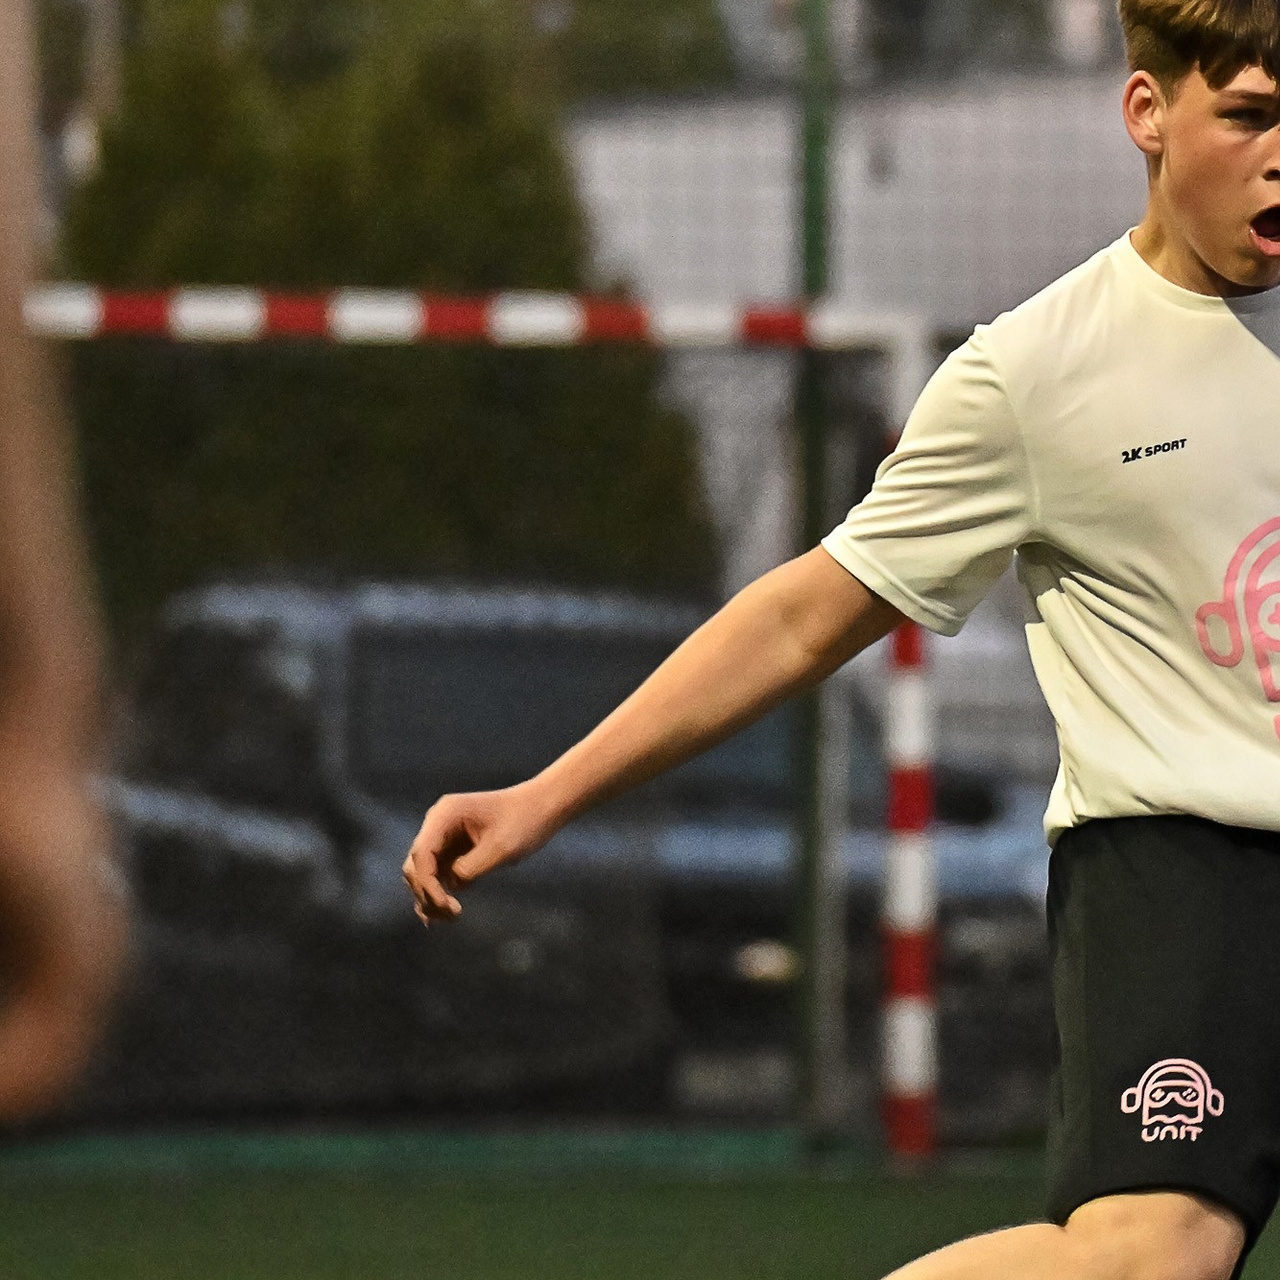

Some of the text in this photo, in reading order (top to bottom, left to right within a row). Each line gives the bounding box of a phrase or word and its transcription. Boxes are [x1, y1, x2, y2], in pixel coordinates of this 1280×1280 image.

[1122, 439, 1187, 463] 2K SPORT
[1141, 1125, 1203, 1142] UNIT
